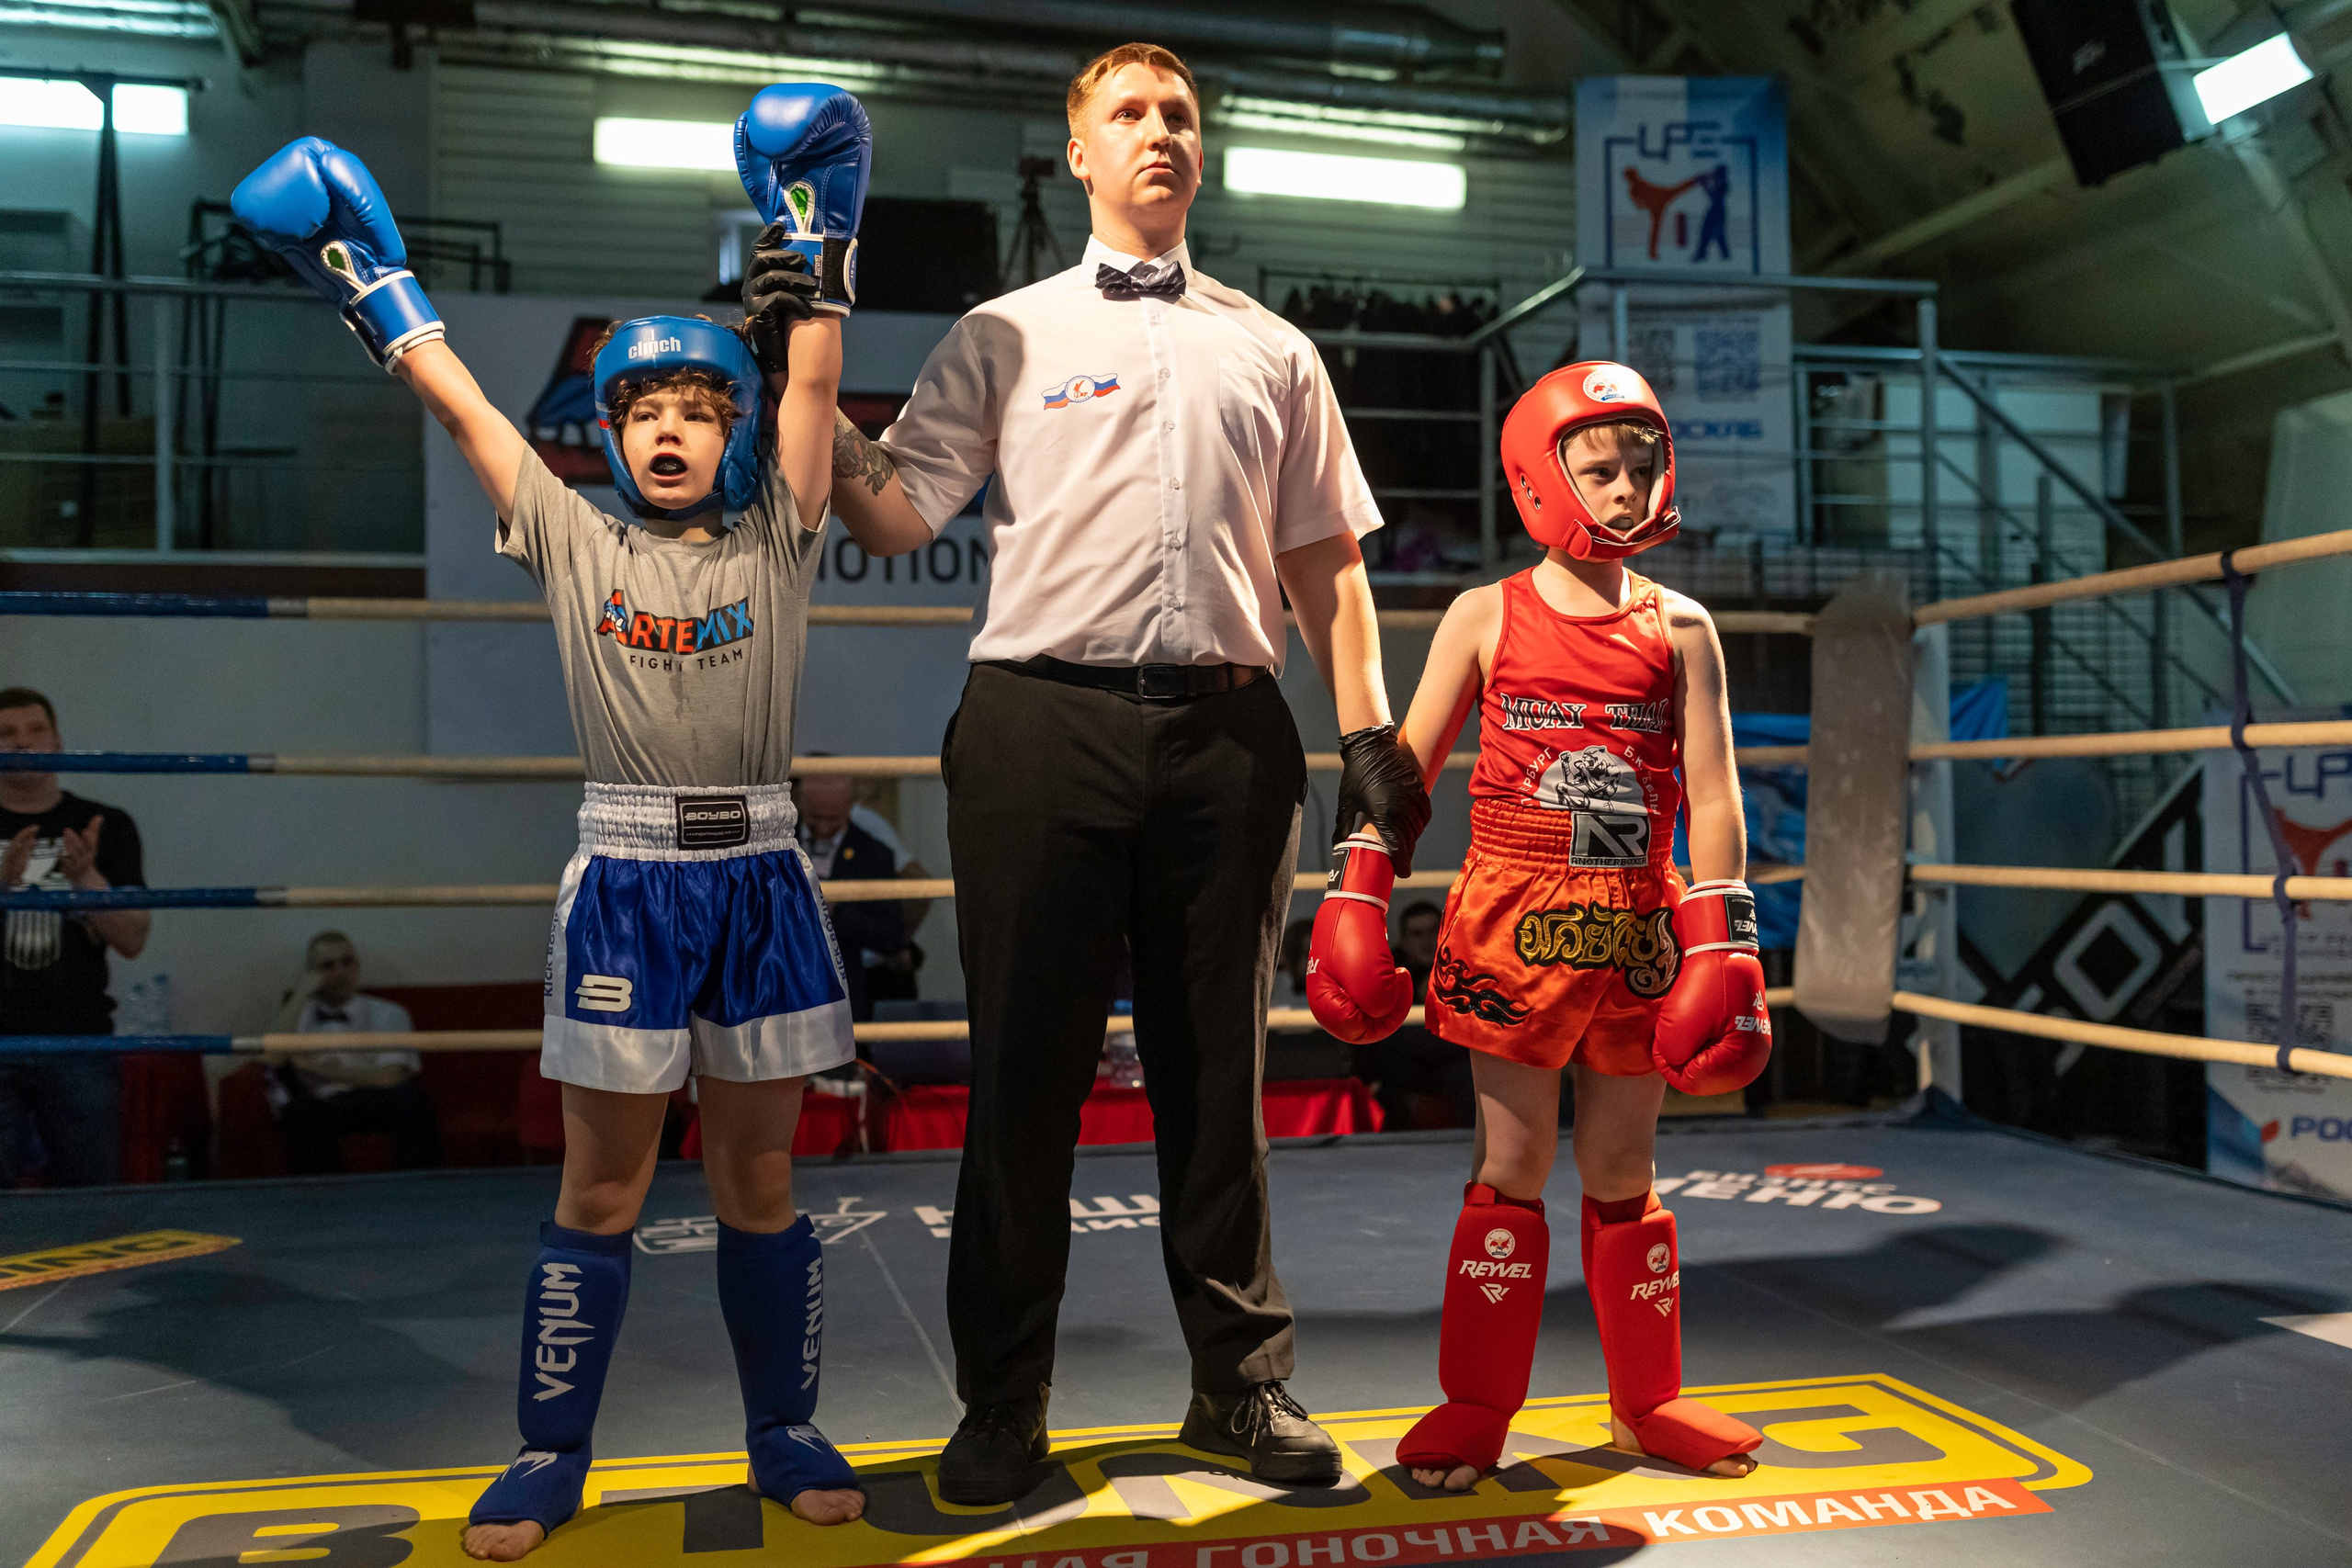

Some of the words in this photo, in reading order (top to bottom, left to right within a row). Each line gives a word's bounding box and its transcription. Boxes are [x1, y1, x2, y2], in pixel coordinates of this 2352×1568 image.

[628, 332, 682, 359] clinch
[818, 536, 989, 583] OION
[595, 590, 754, 654] ARTEMIX
[630, 655, 684, 671] FIGHT
[697, 649, 743, 670] TEAM
[1500, 693, 1587, 731] MUAY
[1605, 698, 1668, 734] THAI
[684, 810, 741, 820] BOYBO
[1570, 856, 1647, 866] ANOTHERBOXER
[1459, 1259, 1532, 1279] REYVEL
[1630, 1270, 1680, 1301] REYVE
[533, 1262, 595, 1402] VENUM
[800, 1257, 823, 1391] VENUM
[1195, 1517, 1610, 1568] ГОНОЧНАЯ
[1643, 1485, 2018, 1538] КОМАНДА
